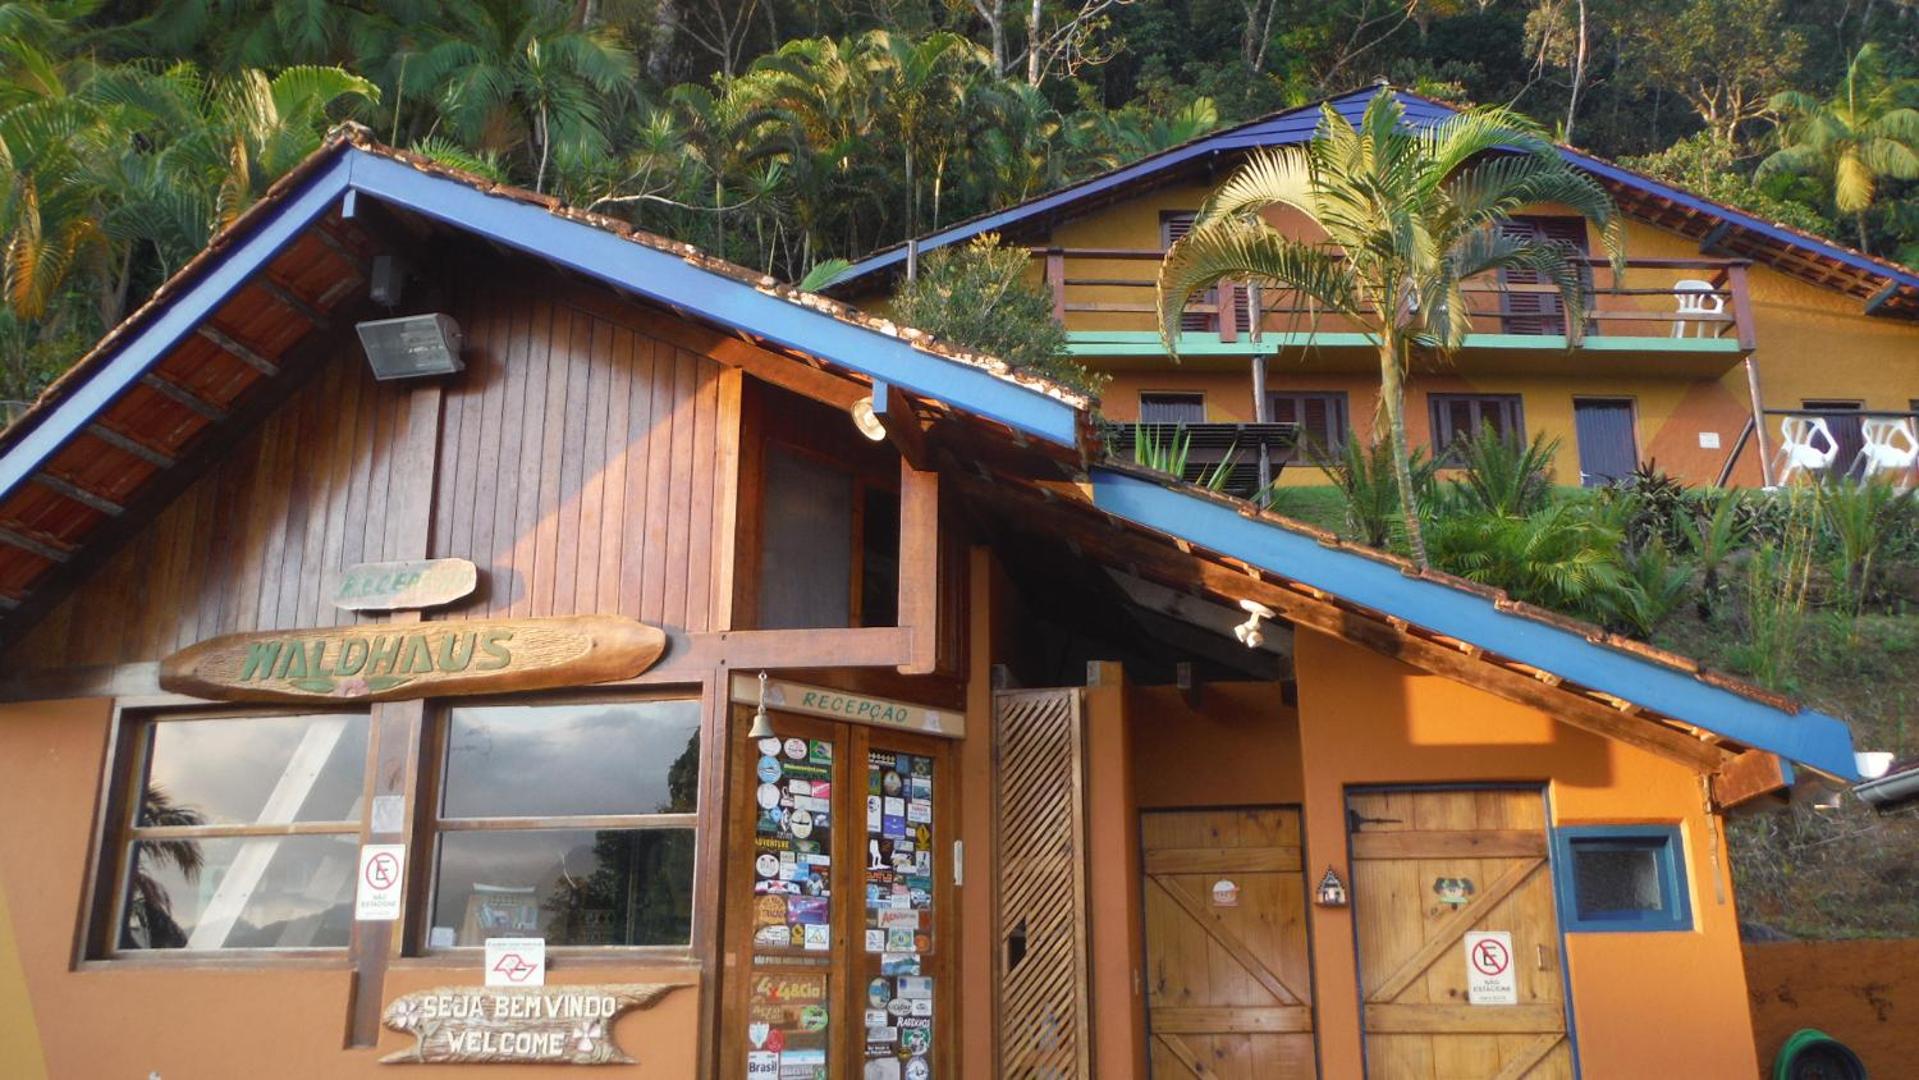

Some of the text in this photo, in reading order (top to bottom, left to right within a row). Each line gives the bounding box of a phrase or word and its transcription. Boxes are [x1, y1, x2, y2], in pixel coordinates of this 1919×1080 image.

[239, 631, 514, 681] WALDHAUS
[423, 994, 617, 1019] SEJA BEM VINDO
[446, 1030, 566, 1056] WELCOME
[749, 1061, 777, 1073] Brasil
